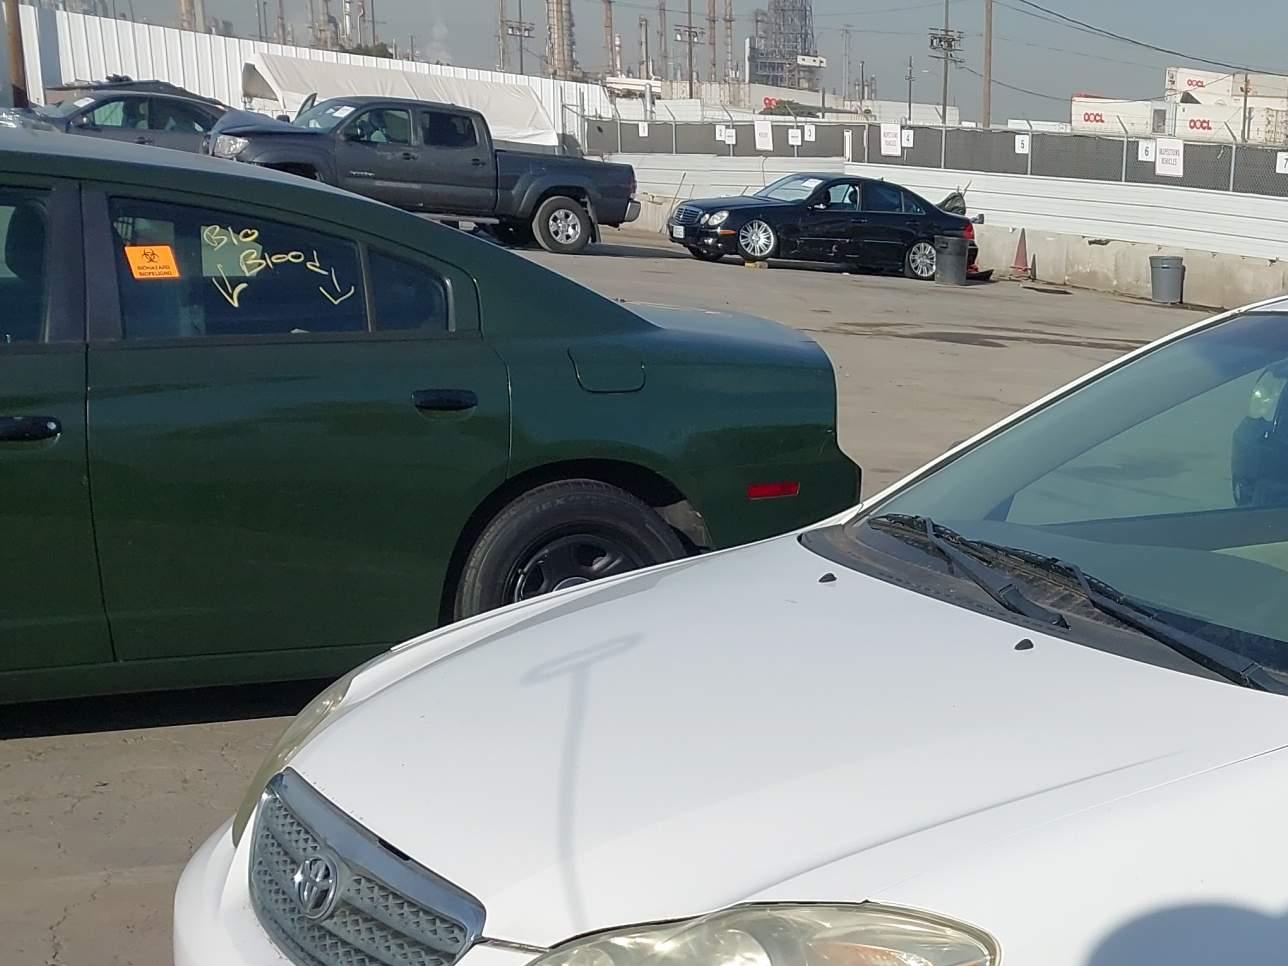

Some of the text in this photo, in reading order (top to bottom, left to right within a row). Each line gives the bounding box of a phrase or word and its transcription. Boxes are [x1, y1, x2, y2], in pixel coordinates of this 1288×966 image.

[1187, 79, 1205, 88] OOCL
[1083, 112, 1104, 124] OOCL
[1189, 119, 1212, 131] OOCL
[1144, 146, 1150, 157] 6
[1283, 158, 1288, 169] 7
